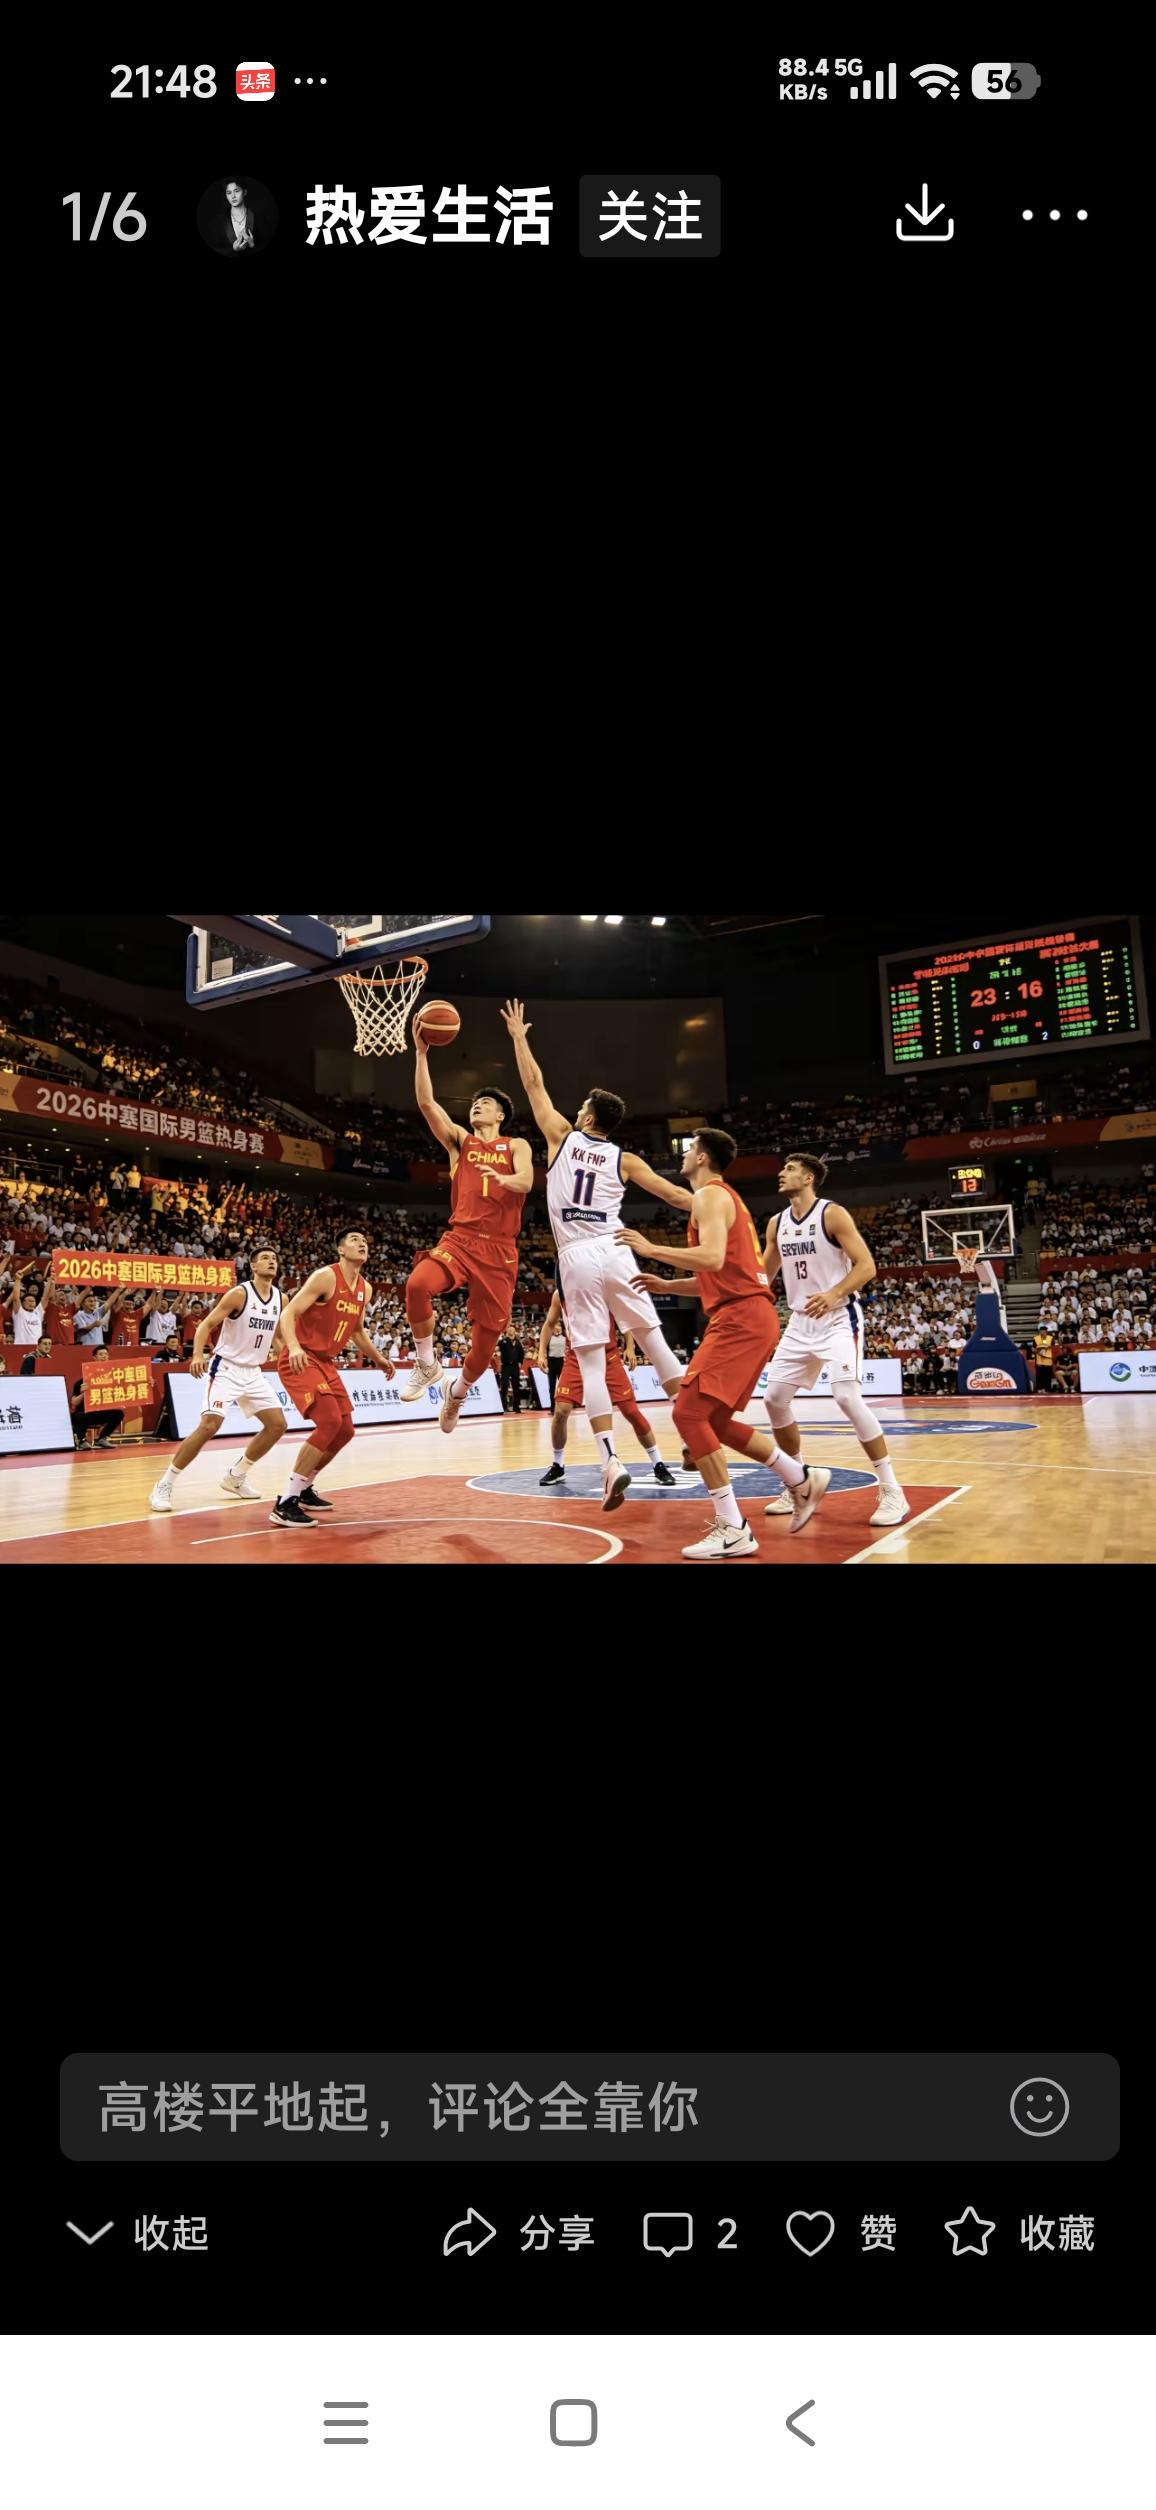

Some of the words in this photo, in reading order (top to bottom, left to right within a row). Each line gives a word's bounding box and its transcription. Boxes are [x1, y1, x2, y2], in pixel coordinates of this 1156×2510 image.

[970, 988, 997, 1007] 23
[1017, 980, 1043, 999] 16
[1041, 1031, 1049, 1040] 2
[36, 1087, 265, 1156] 2026中塞国际男篮热身赛
[467, 1150, 509, 1165] CHINA
[572, 1168, 597, 1207] 11
[57, 1258, 233, 1288] 2026中塞国际男篮热身赛
[794, 1260, 808, 1280] 13
[333, 1319, 349, 1343] 11
